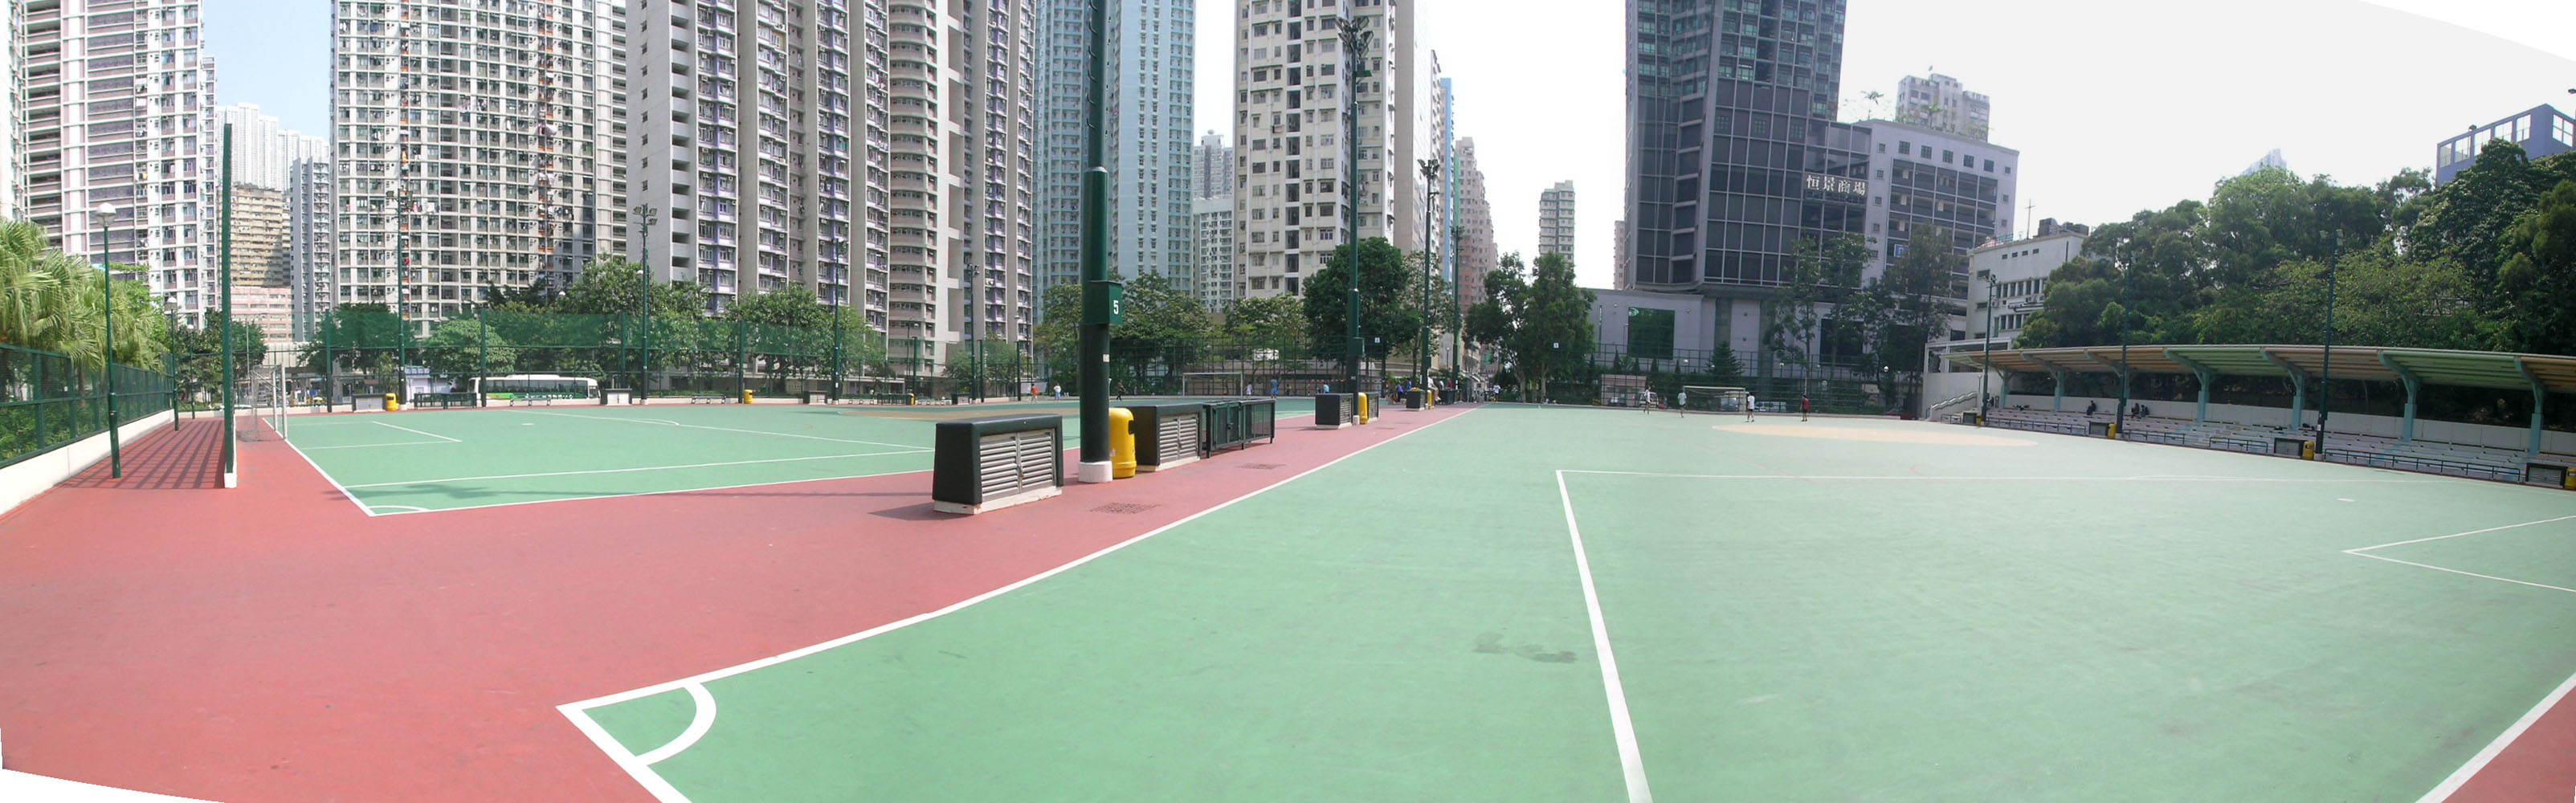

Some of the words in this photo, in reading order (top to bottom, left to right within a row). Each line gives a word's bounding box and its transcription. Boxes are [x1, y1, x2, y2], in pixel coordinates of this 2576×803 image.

[1806, 174, 1865, 196] 恒景商場
[1113, 300, 1119, 315] 5
